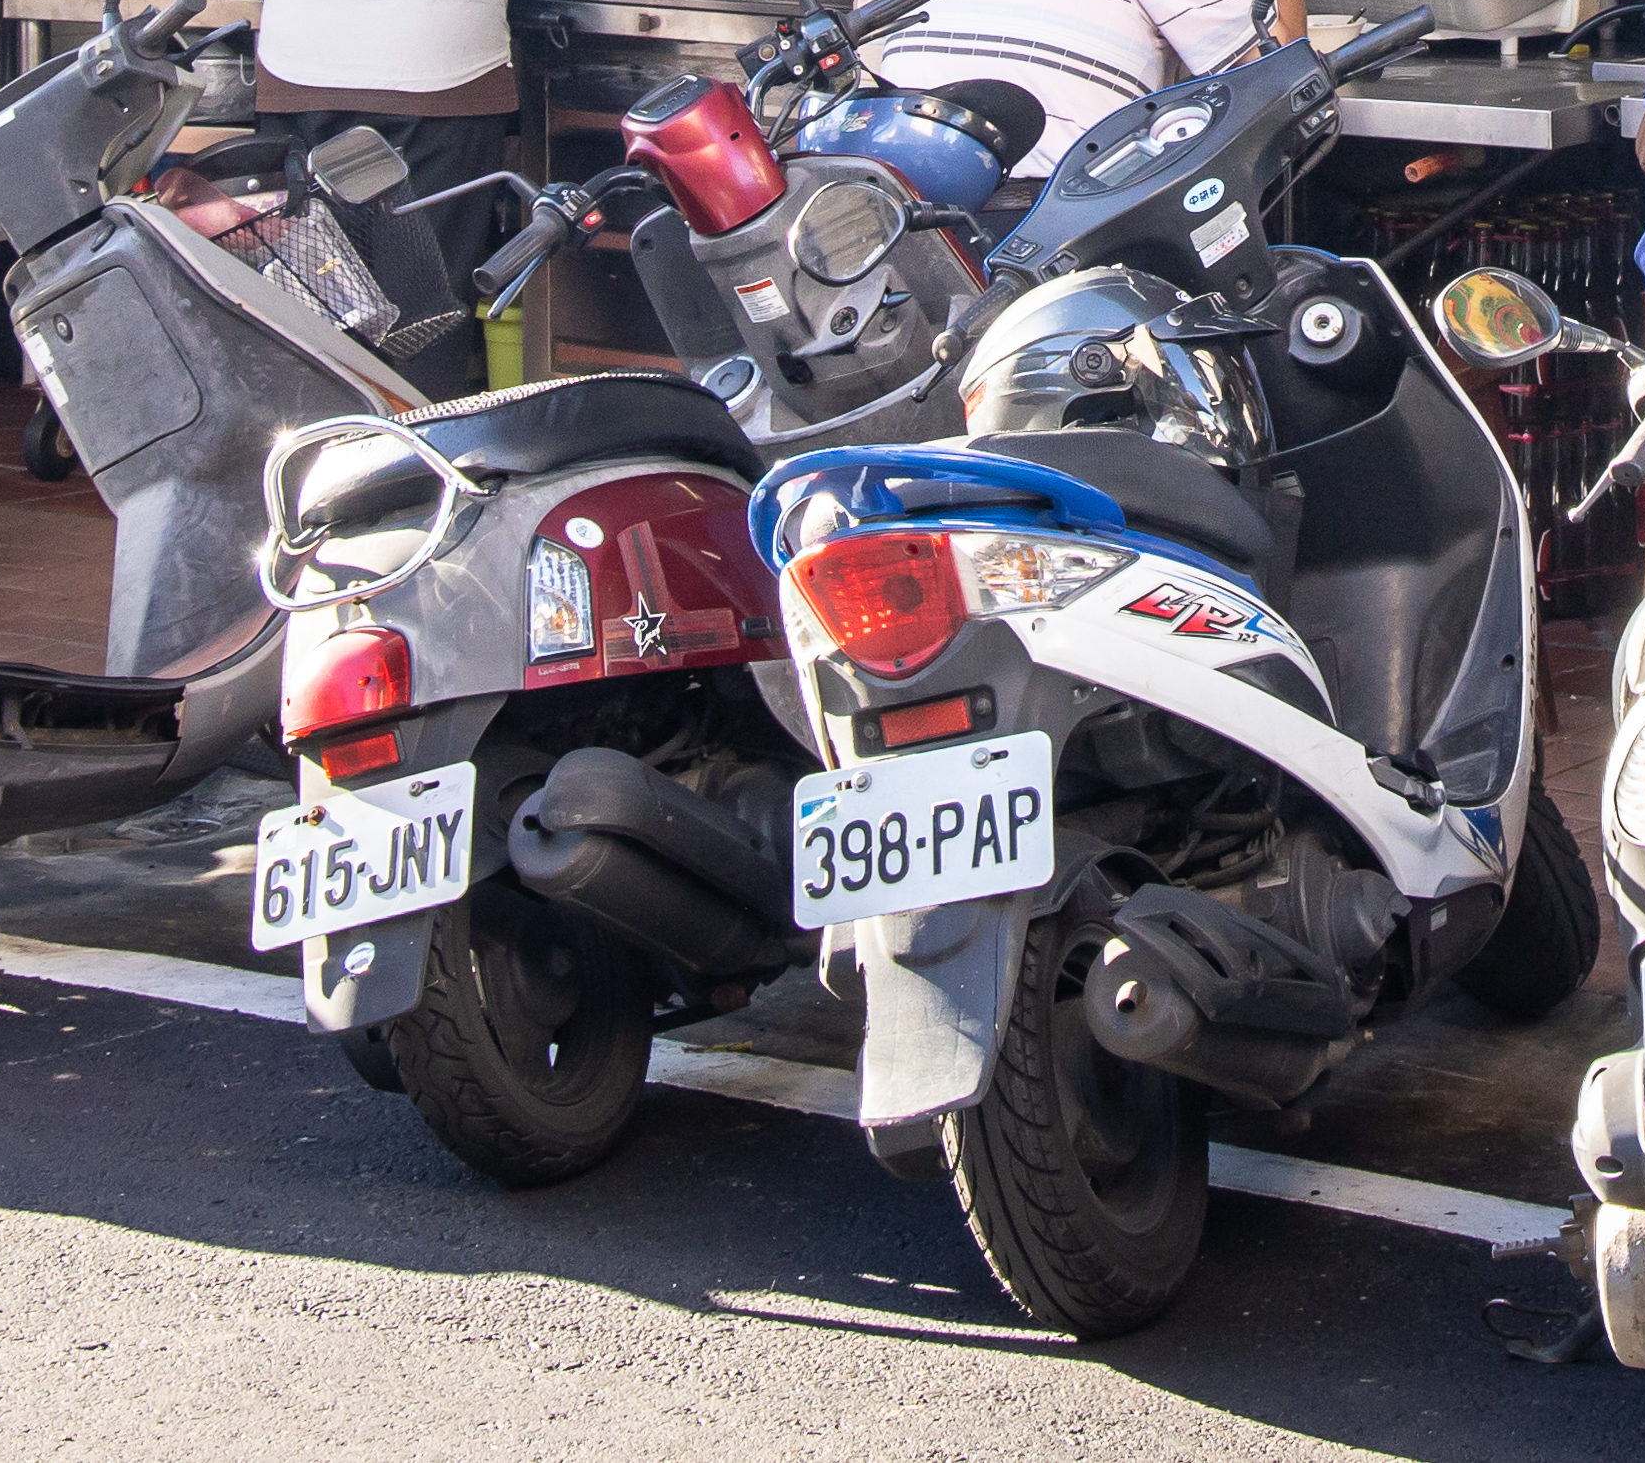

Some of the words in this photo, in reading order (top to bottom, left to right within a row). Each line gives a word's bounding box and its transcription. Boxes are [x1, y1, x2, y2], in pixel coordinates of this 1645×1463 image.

[1236, 631, 1260, 644] 125
[262, 808, 465, 926] 615-JNY
[801, 786, 1043, 900] 398-PAP
